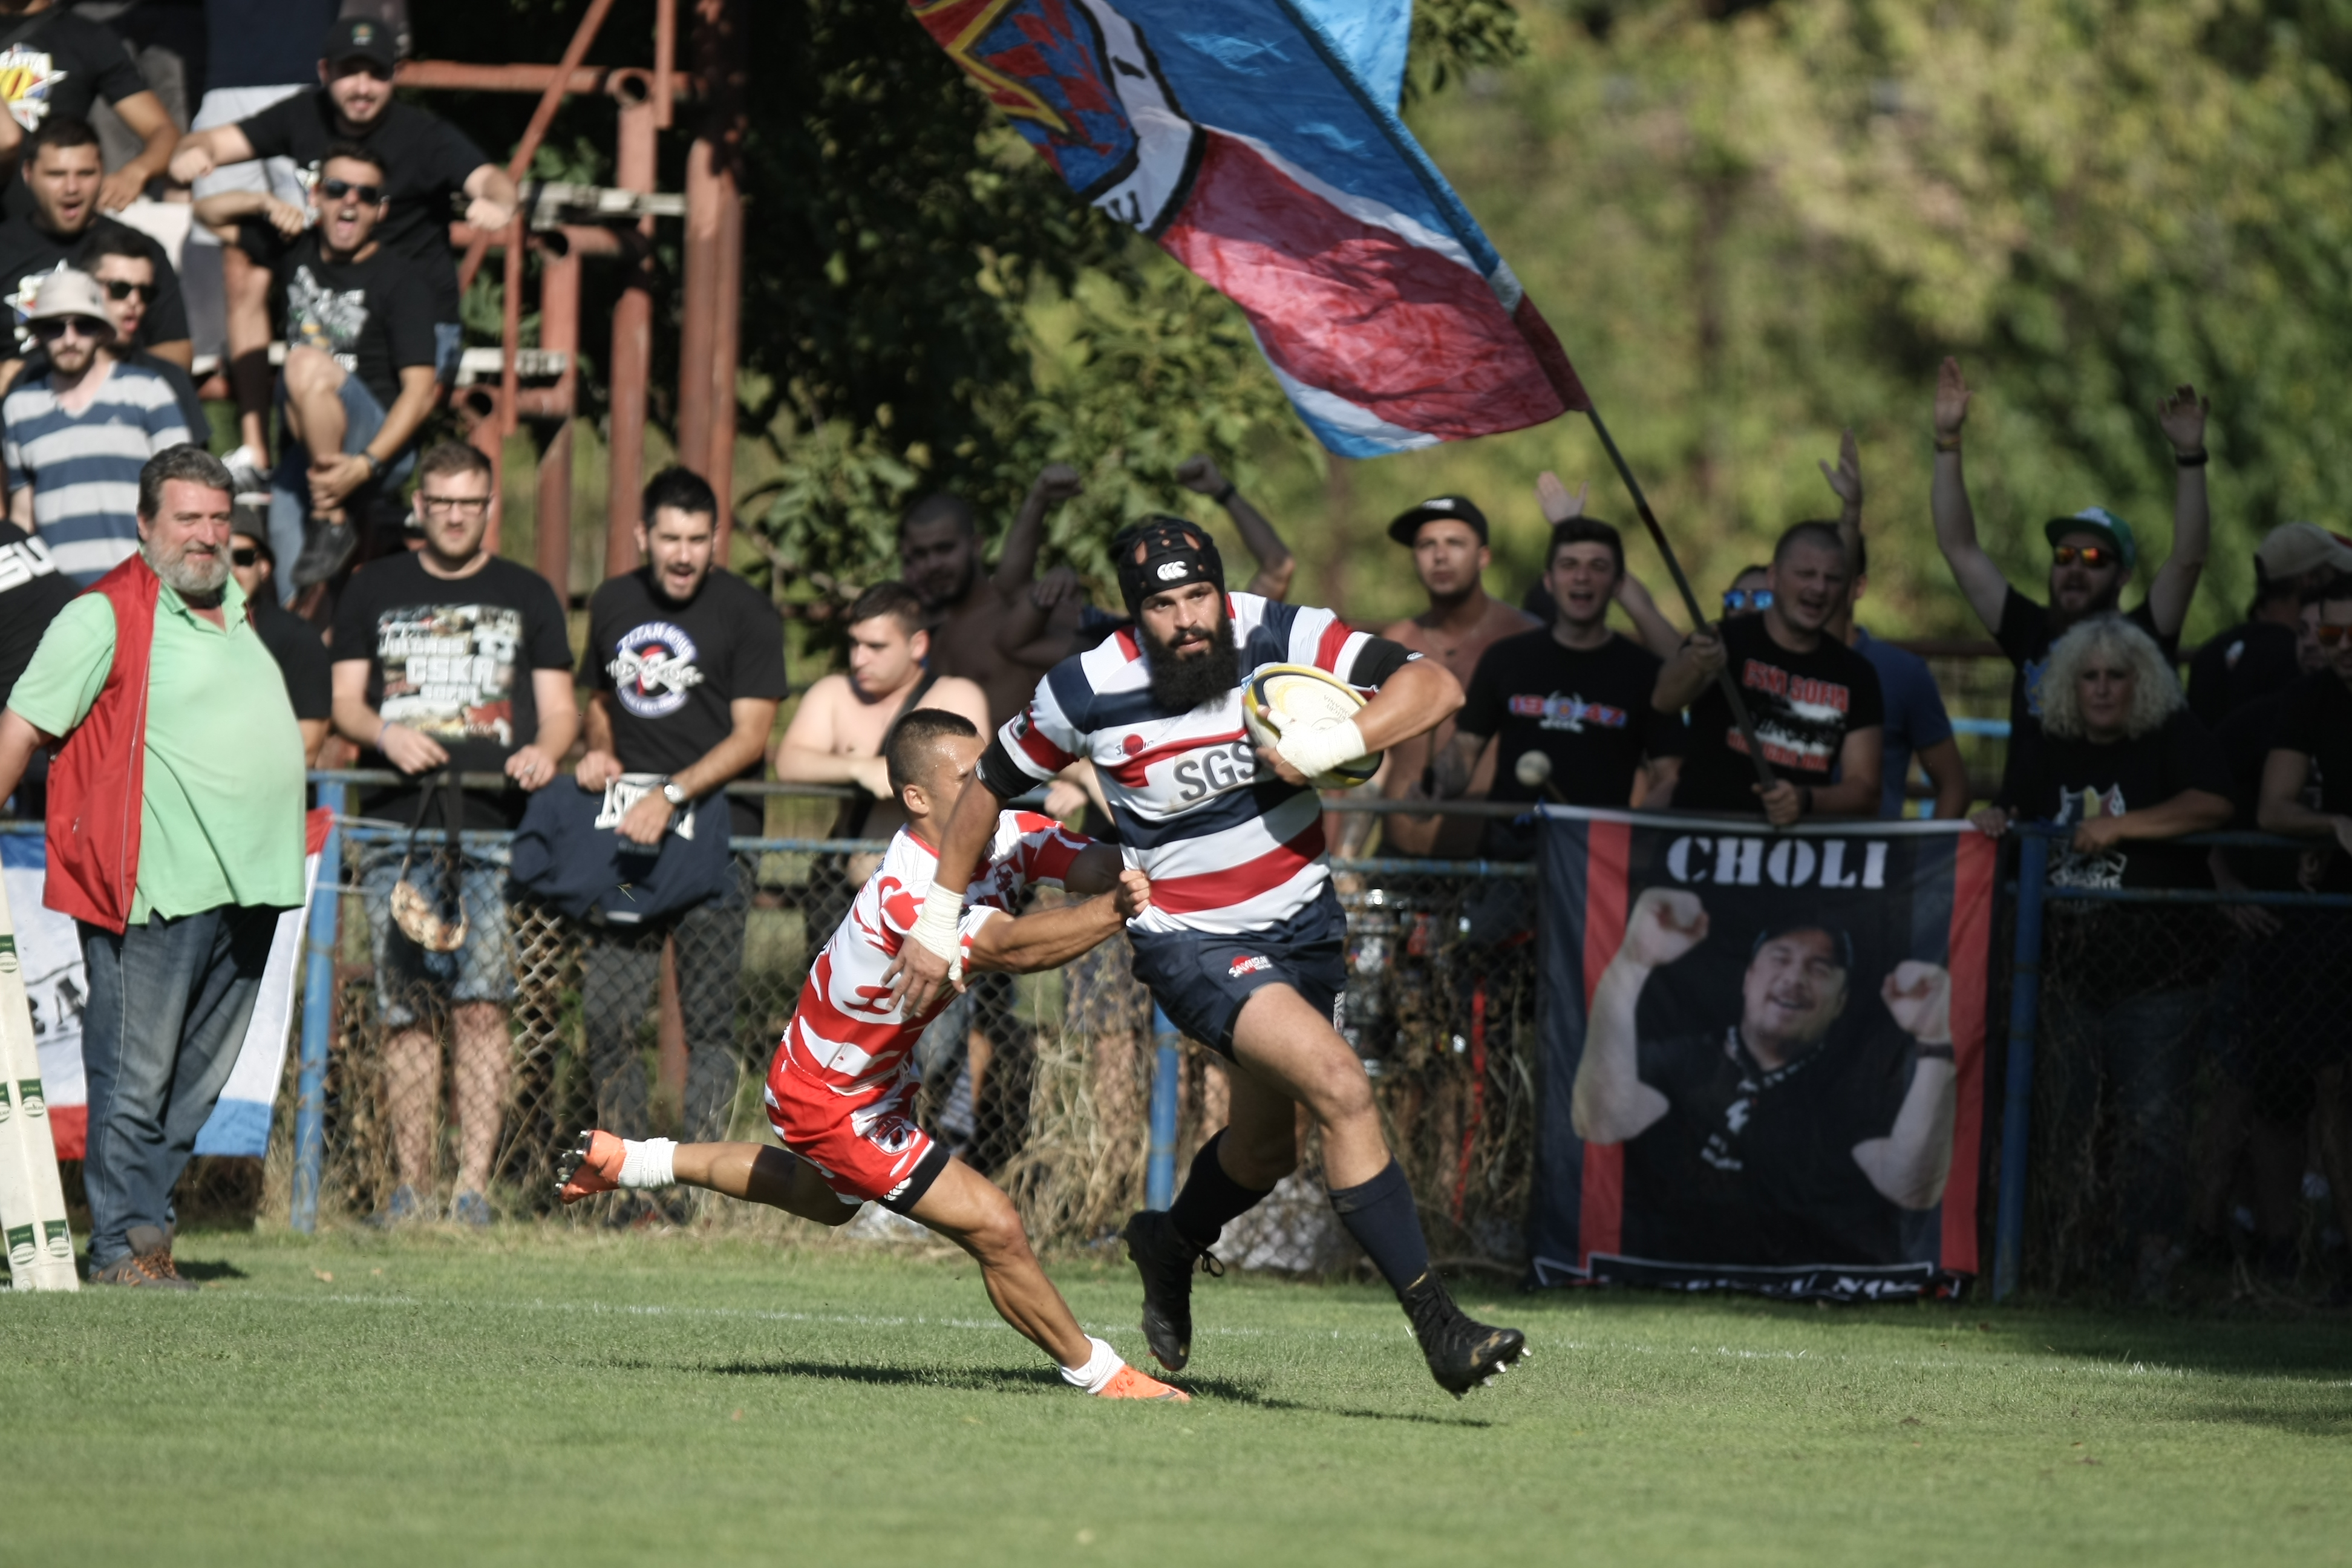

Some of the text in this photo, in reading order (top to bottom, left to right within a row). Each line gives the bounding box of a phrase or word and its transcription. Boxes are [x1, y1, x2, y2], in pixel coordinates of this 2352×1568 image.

[405, 655, 500, 695] CSKA
[1789, 674, 1851, 714] SOFIA
[1174, 741, 1256, 802] SGS
[1667, 835, 1889, 890] CHOLI
